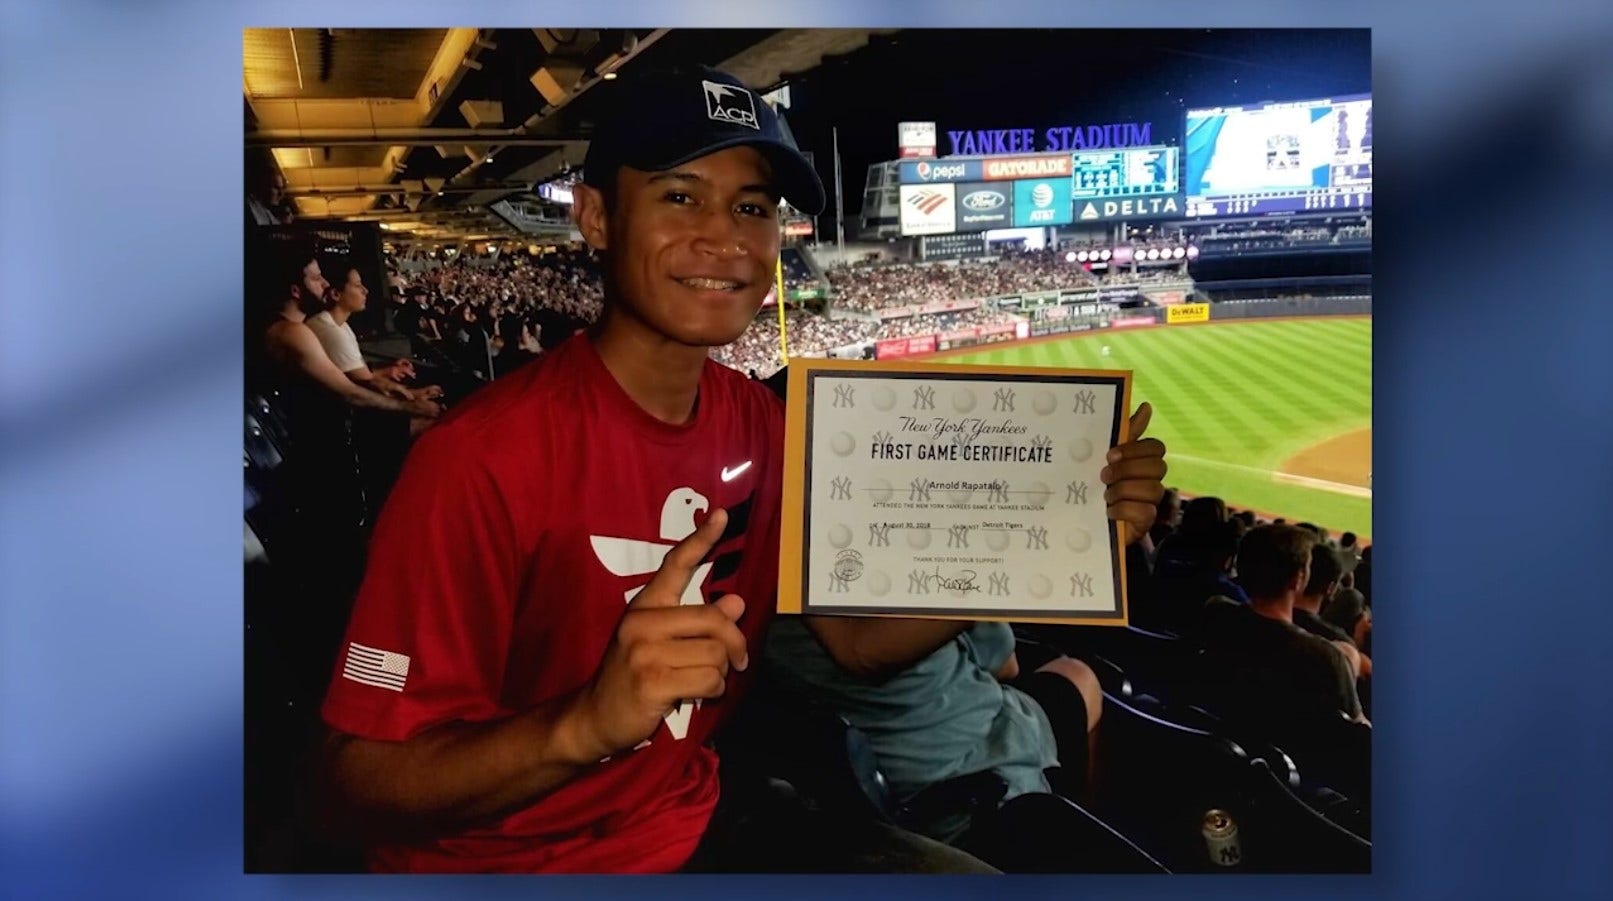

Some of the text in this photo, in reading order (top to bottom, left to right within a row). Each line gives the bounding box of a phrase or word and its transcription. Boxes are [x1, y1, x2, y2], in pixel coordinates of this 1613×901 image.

[713, 105, 754, 122] ACP
[947, 121, 1151, 155] YANKEE STADIUM
[933, 163, 965, 179] pepsi
[988, 159, 1067, 177] GATORADE
[1104, 197, 1178, 216] DELTA
[899, 416, 1028, 441] New York Yankees
[871, 443, 1053, 463] FIRST GAME CERTIFICATE
[929, 481, 960, 490] Arnold
[973, 503, 988, 511] GAME
[982, 521, 1003, 529] Detroit
[1005, 522, 1023, 530] Tigers
